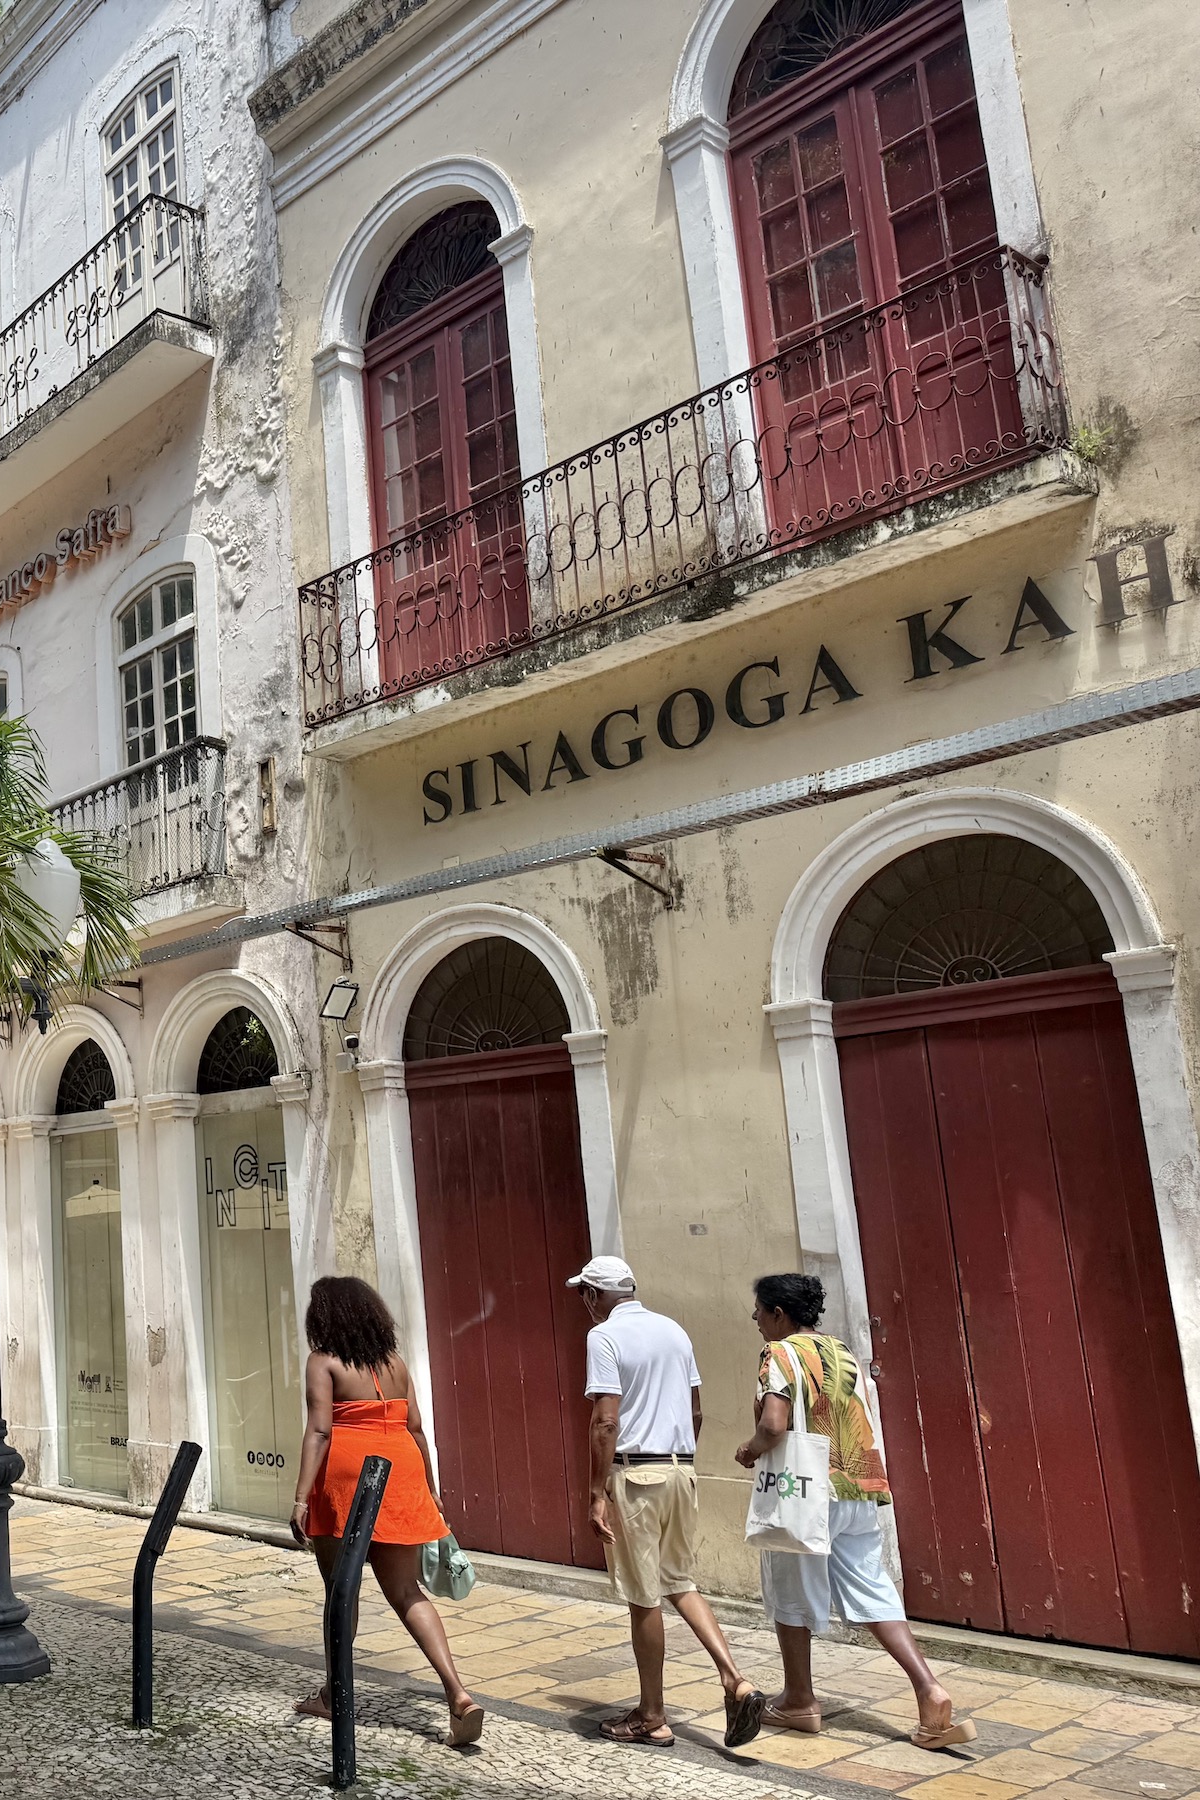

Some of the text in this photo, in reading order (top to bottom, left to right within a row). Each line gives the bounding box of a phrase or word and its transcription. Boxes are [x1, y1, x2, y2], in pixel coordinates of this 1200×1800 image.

[55, 504, 131, 568] Safra
[423, 529, 1185, 827] SINAGOGA KAH
[756, 1468, 813, 1499] SPOT
